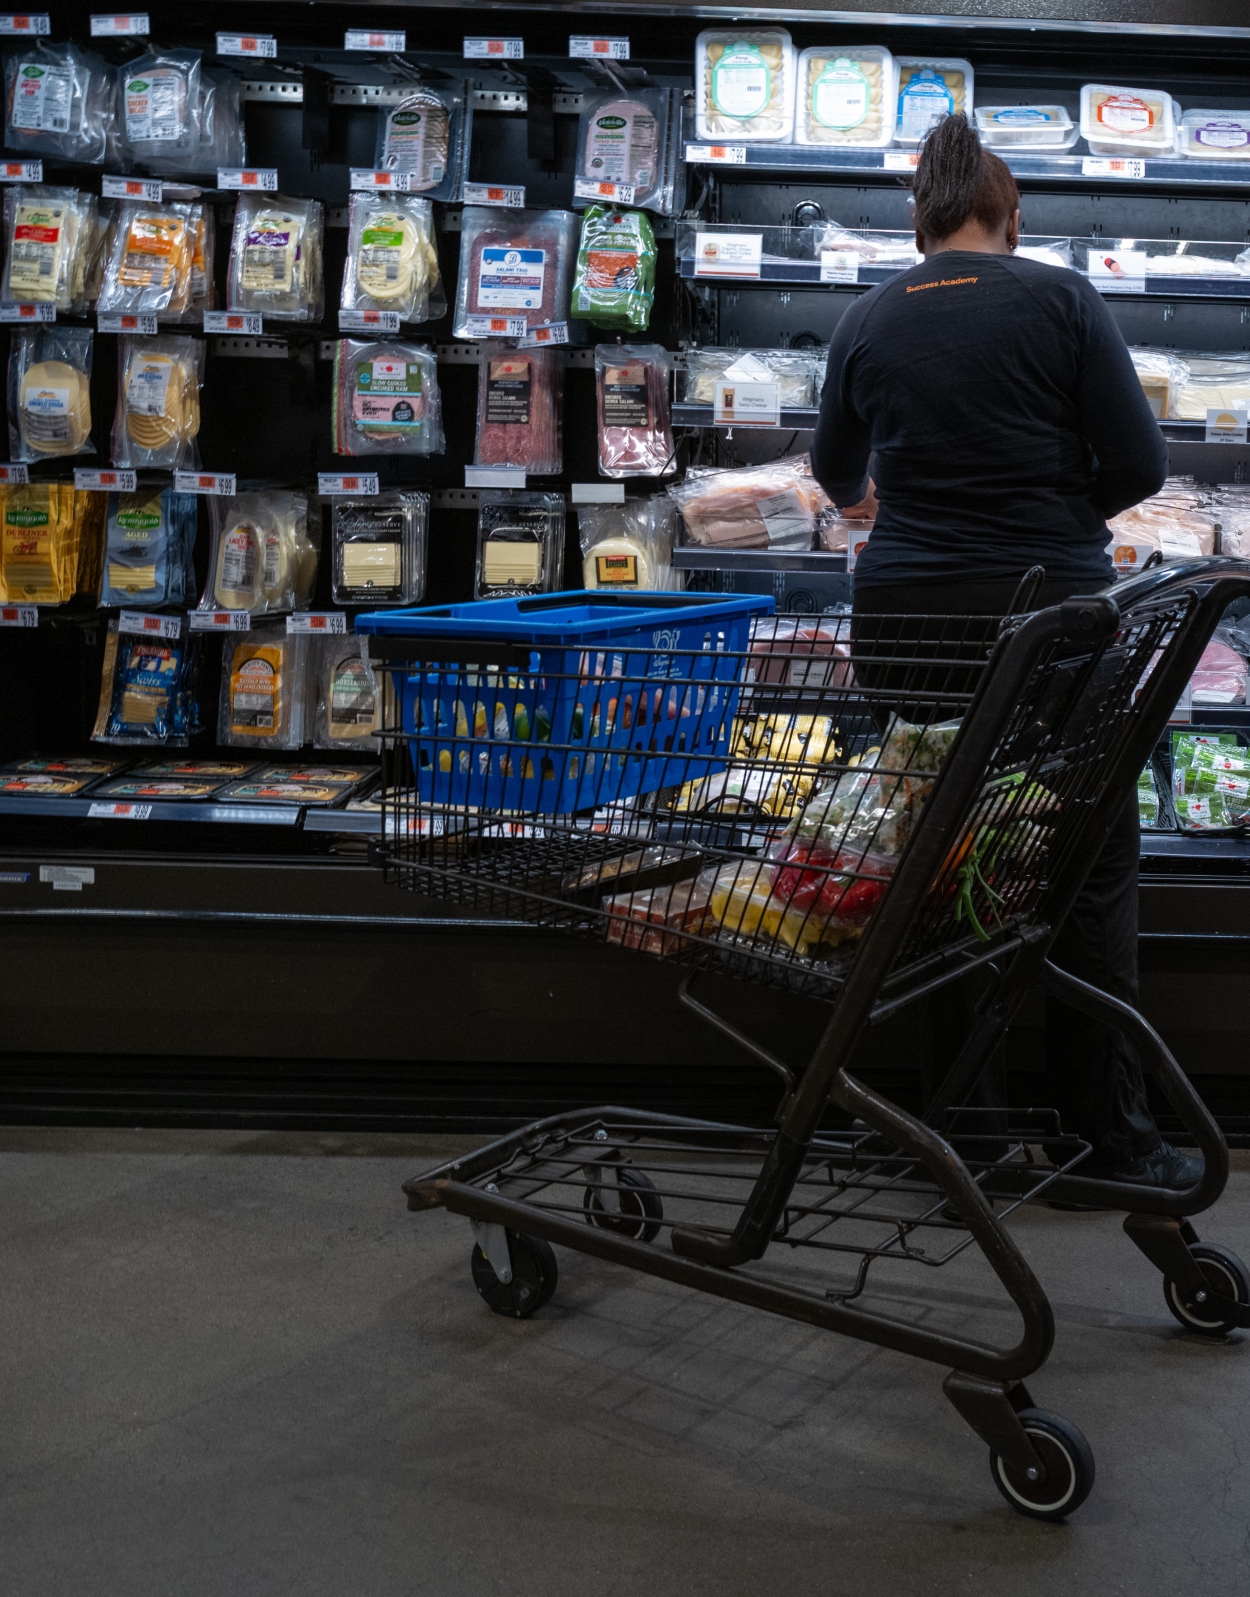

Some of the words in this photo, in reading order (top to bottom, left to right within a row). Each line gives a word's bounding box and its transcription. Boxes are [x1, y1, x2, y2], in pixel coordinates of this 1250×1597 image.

[906, 281, 939, 293] Success
[940, 276, 979, 286] Academy
[7, 513, 48, 524] Kerrygold
[118, 516, 160, 526] Kerrygold
[135, 674, 161, 687] Swiss
